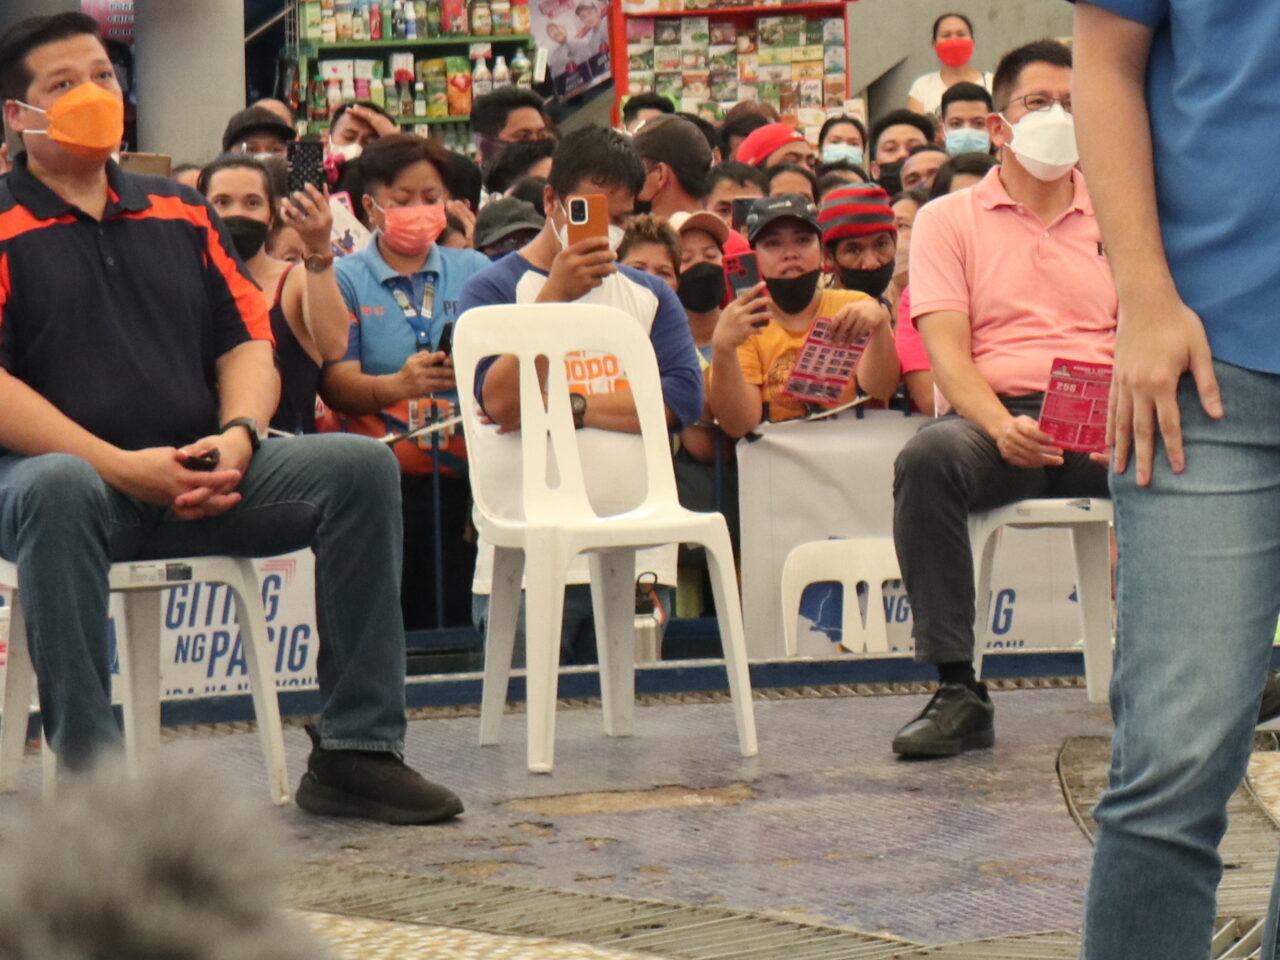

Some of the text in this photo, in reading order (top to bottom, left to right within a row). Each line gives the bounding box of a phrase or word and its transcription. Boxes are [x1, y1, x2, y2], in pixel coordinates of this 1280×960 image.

[165, 574, 282, 630] GITIG
[174, 623, 311, 678] NG PAIG
